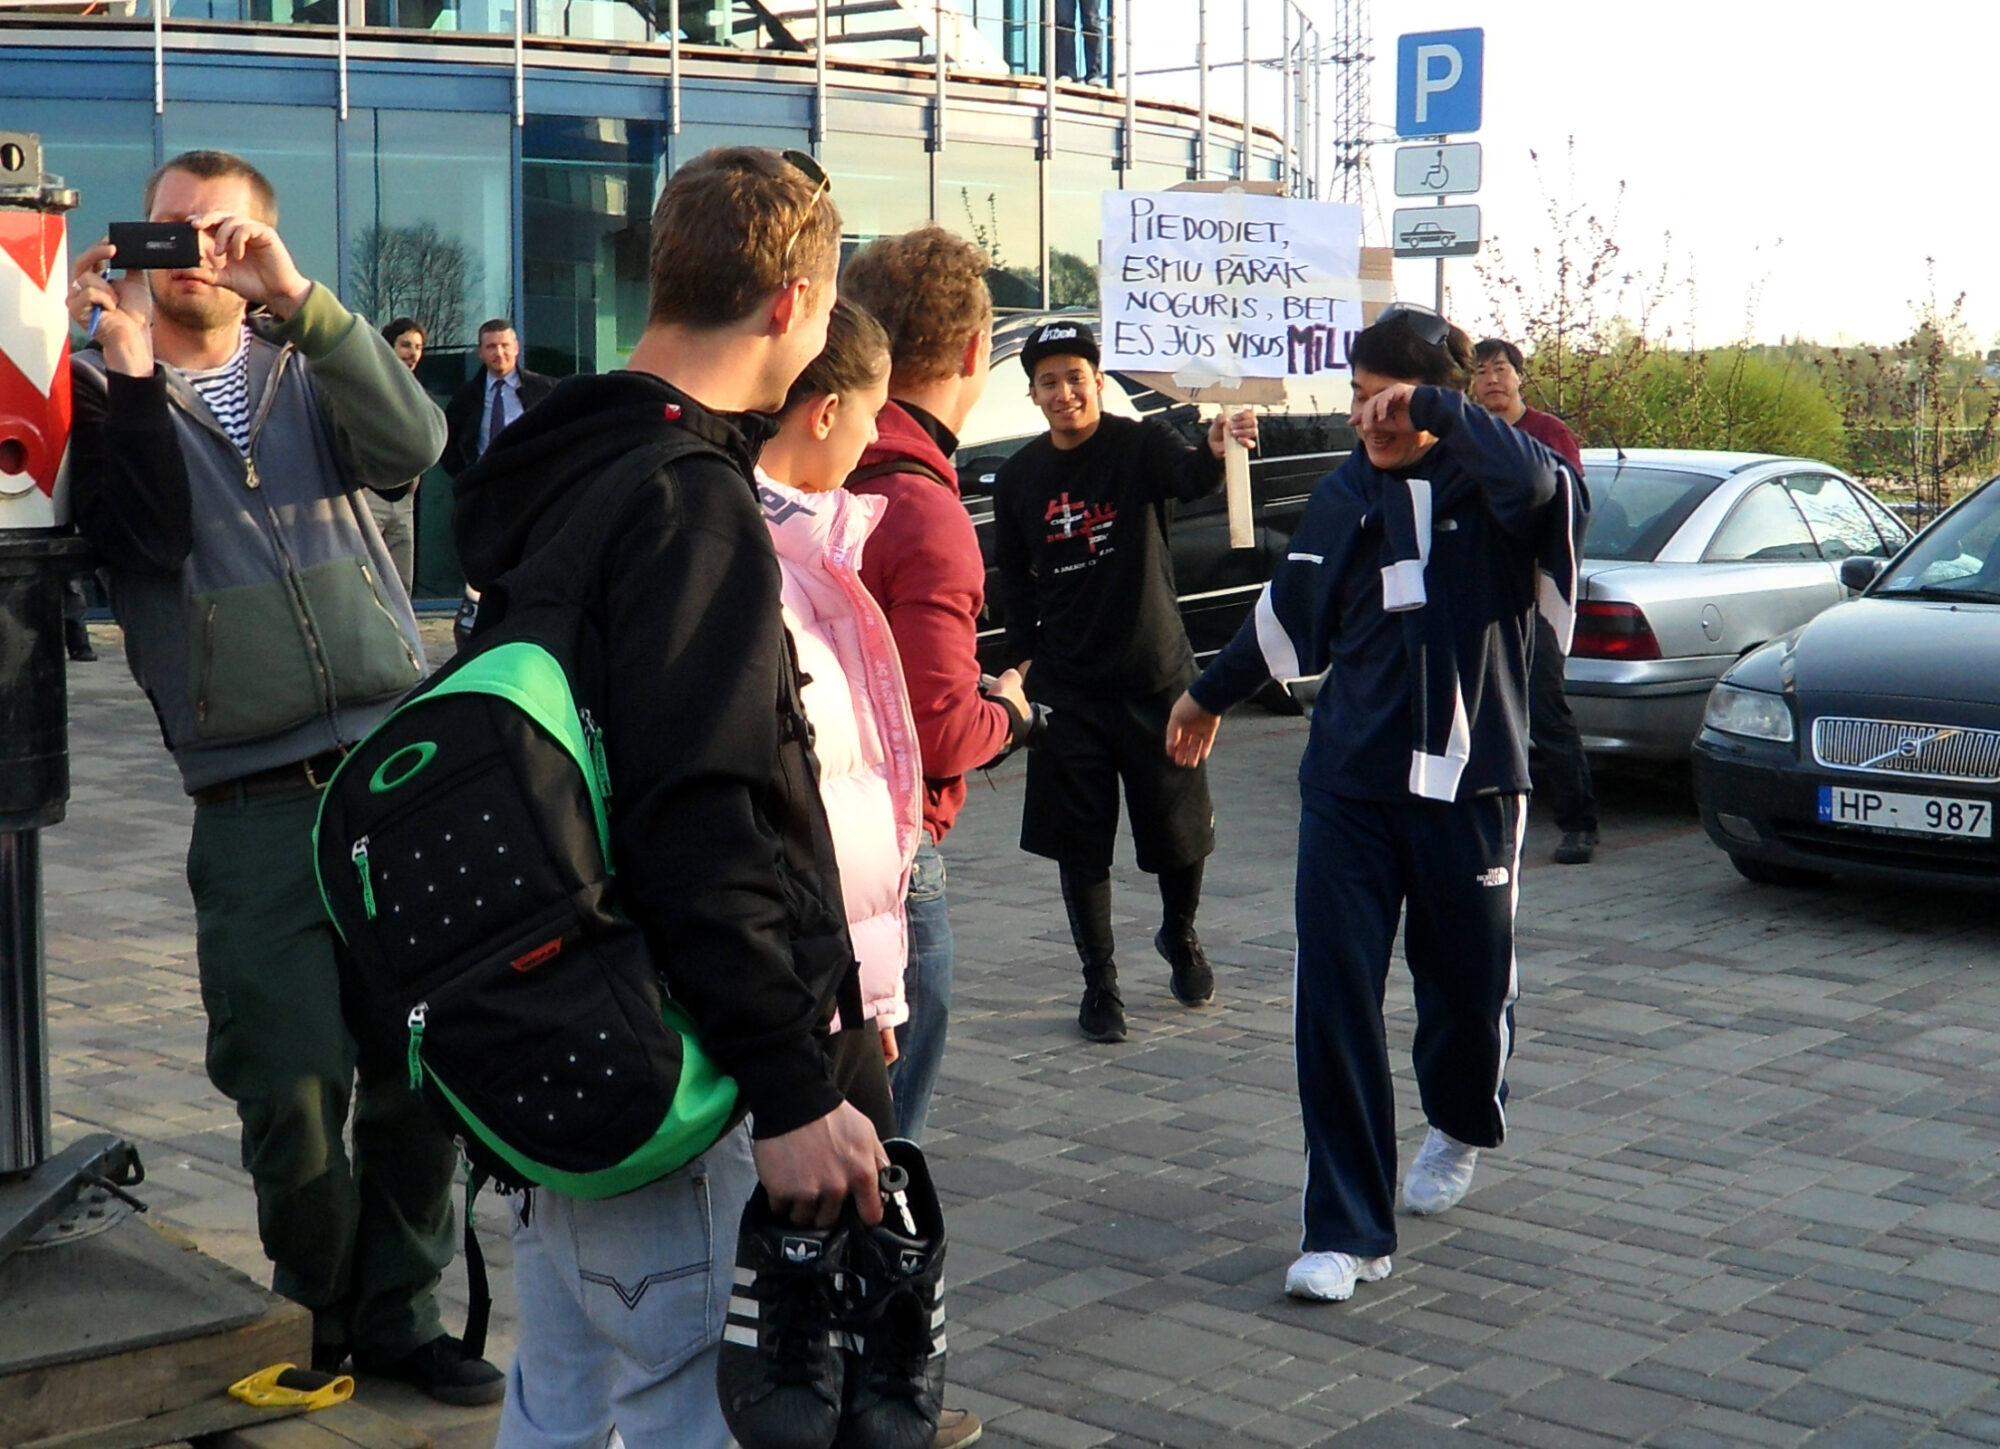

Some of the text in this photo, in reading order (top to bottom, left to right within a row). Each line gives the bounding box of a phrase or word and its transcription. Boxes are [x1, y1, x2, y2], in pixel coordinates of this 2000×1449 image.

[1415, 43, 1463, 123] P
[1130, 197, 1290, 249] PIEDODIET,
[1122, 255, 1203, 282] ESMU
[1125, 291, 1347, 322] NOGURIS, BET
[1115, 321, 1154, 356] ES
[1227, 331, 1285, 358] VISUS
[1925, 800, 1986, 833] 987
